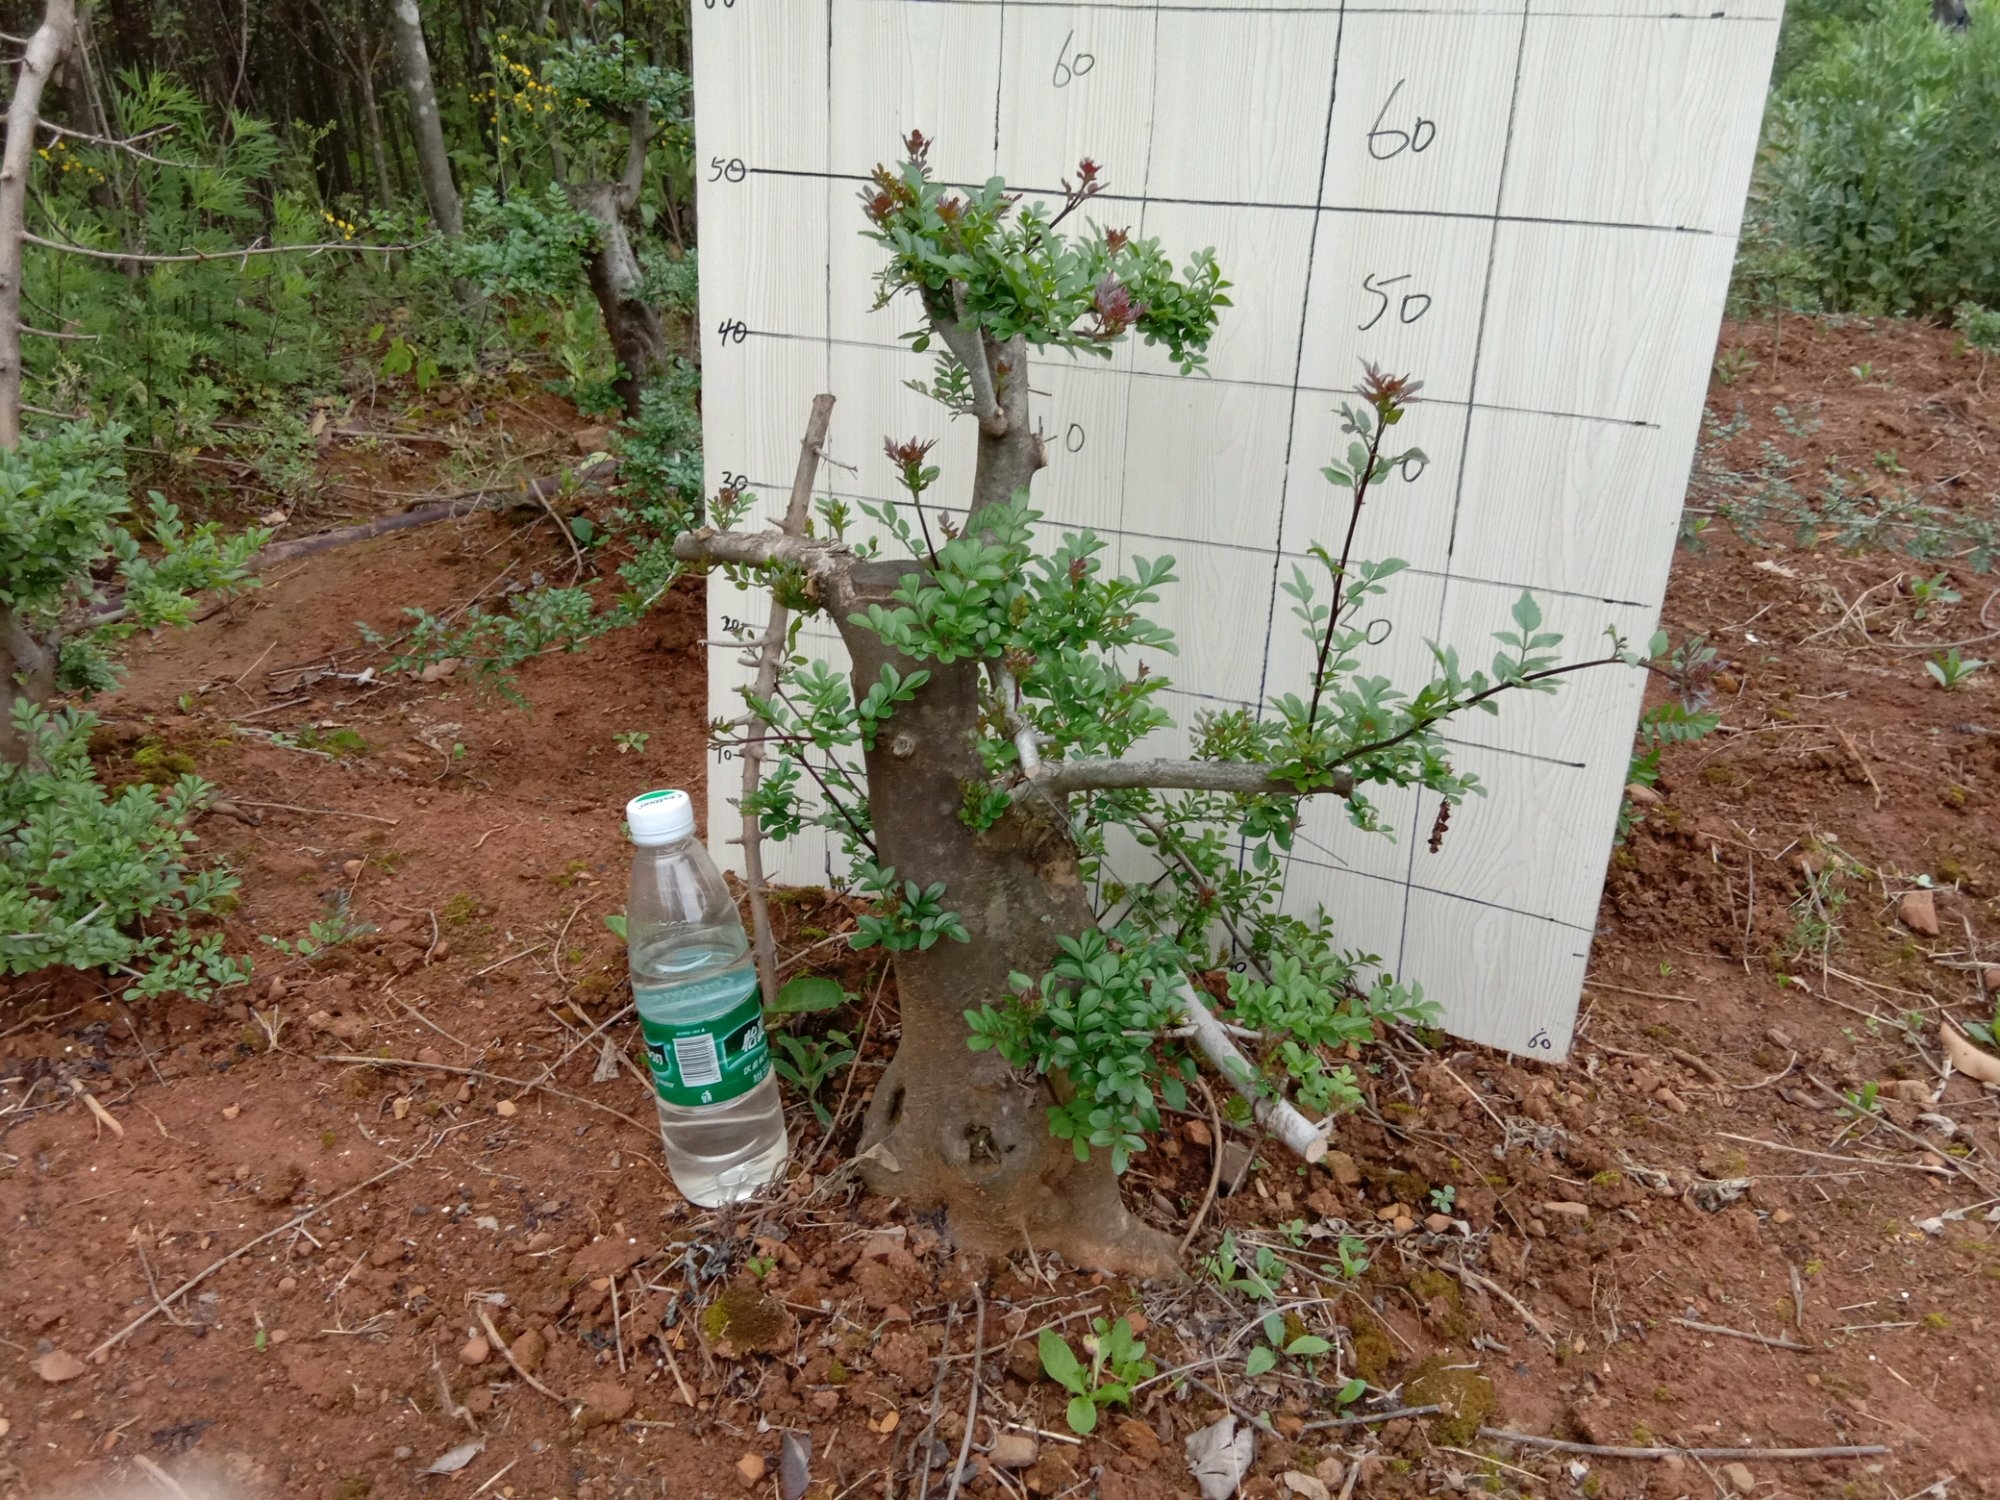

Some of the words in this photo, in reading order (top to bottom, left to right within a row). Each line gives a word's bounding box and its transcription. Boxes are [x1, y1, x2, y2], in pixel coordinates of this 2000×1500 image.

[1052, 29, 1094, 88] 60
[1366, 78, 1436, 160] 60
[708, 157, 746, 183] 50
[1357, 272, 1432, 331] 50
[718, 320, 748, 347] 40
[721, 470, 749, 493] 30
[721, 614, 741, 633] 20
[717, 748, 733, 765] 10
[1528, 1030, 1551, 1050] 60
